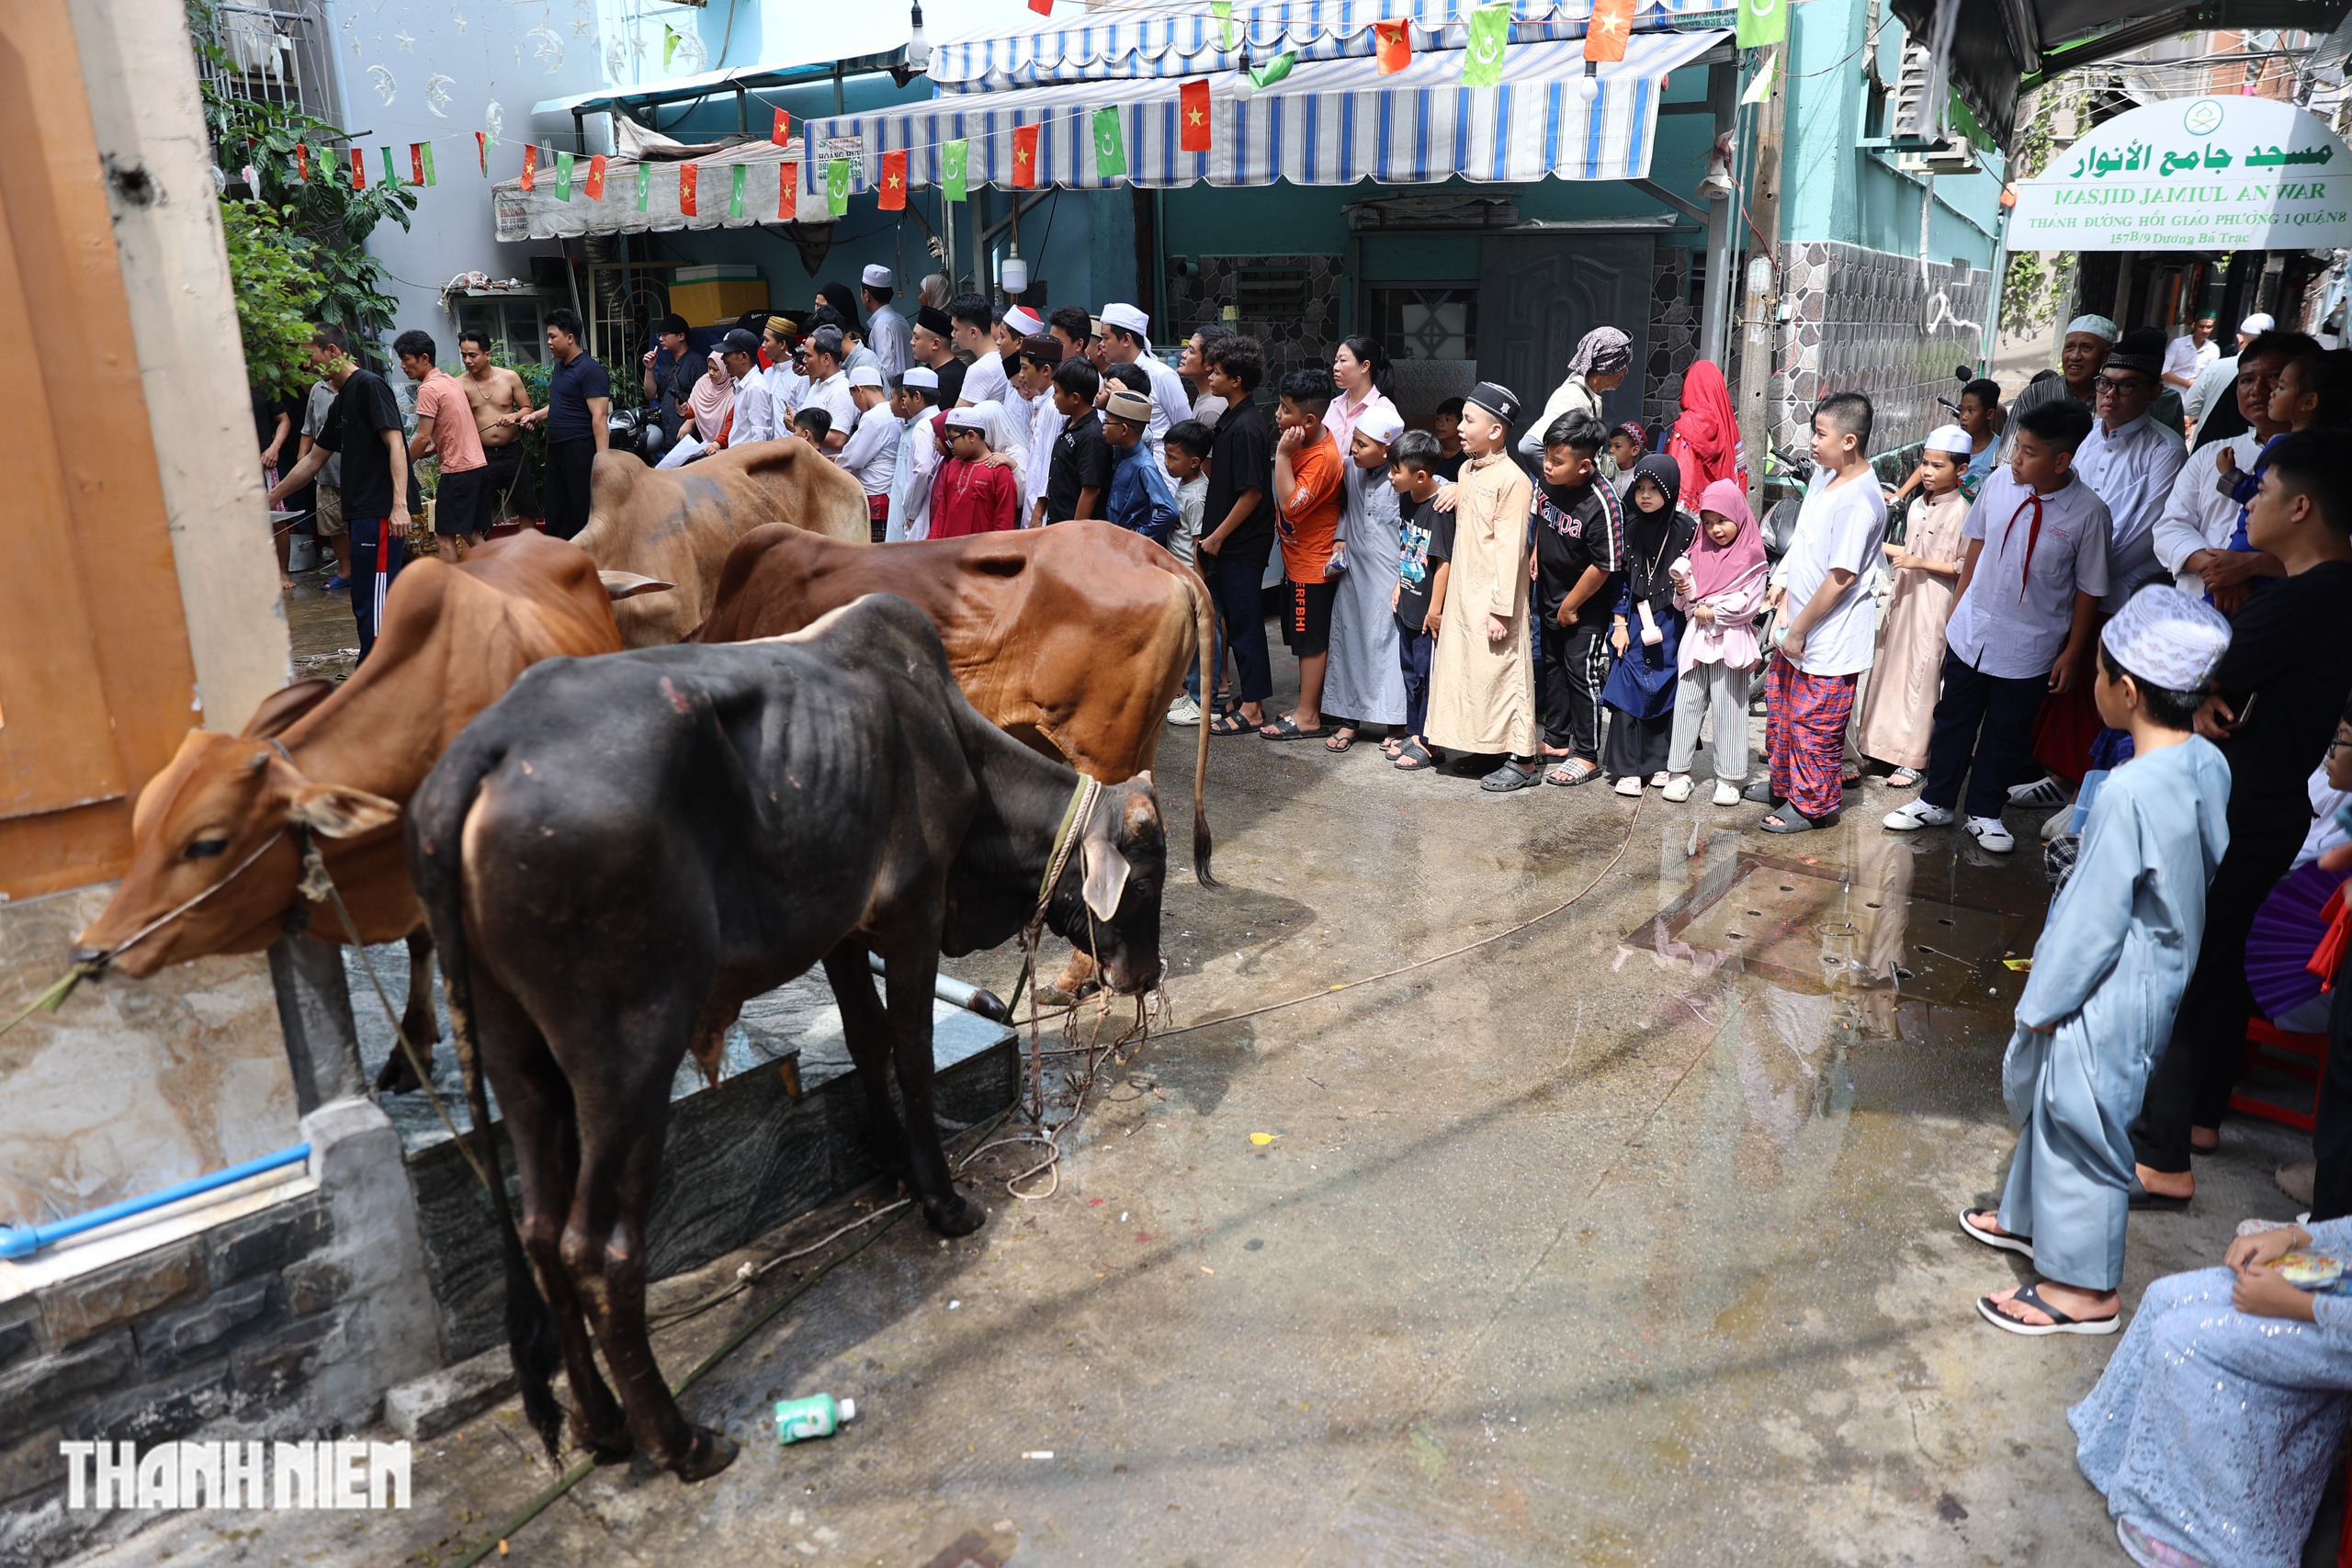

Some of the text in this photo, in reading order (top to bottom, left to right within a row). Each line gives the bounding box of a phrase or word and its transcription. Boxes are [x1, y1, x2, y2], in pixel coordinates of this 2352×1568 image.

[2069, 138, 2335, 178] مسجد جامع الأنوار
[2053, 187, 2135, 205] MASJID
[2139, 186, 2228, 205] JAMIUL
[2029, 212, 2077, 229] THÁNH
[2084, 212, 2132, 228] ĐƯỜNG
[2138, 209, 2165, 227] HỒI
[2171, 209, 2209, 226] GIÁO
[2215, 209, 2279, 225] PHƯỜNG
[2109, 231, 2249, 245] 157B/9 Dương Bá Trạc
[1538, 486, 1583, 539] Kappa
